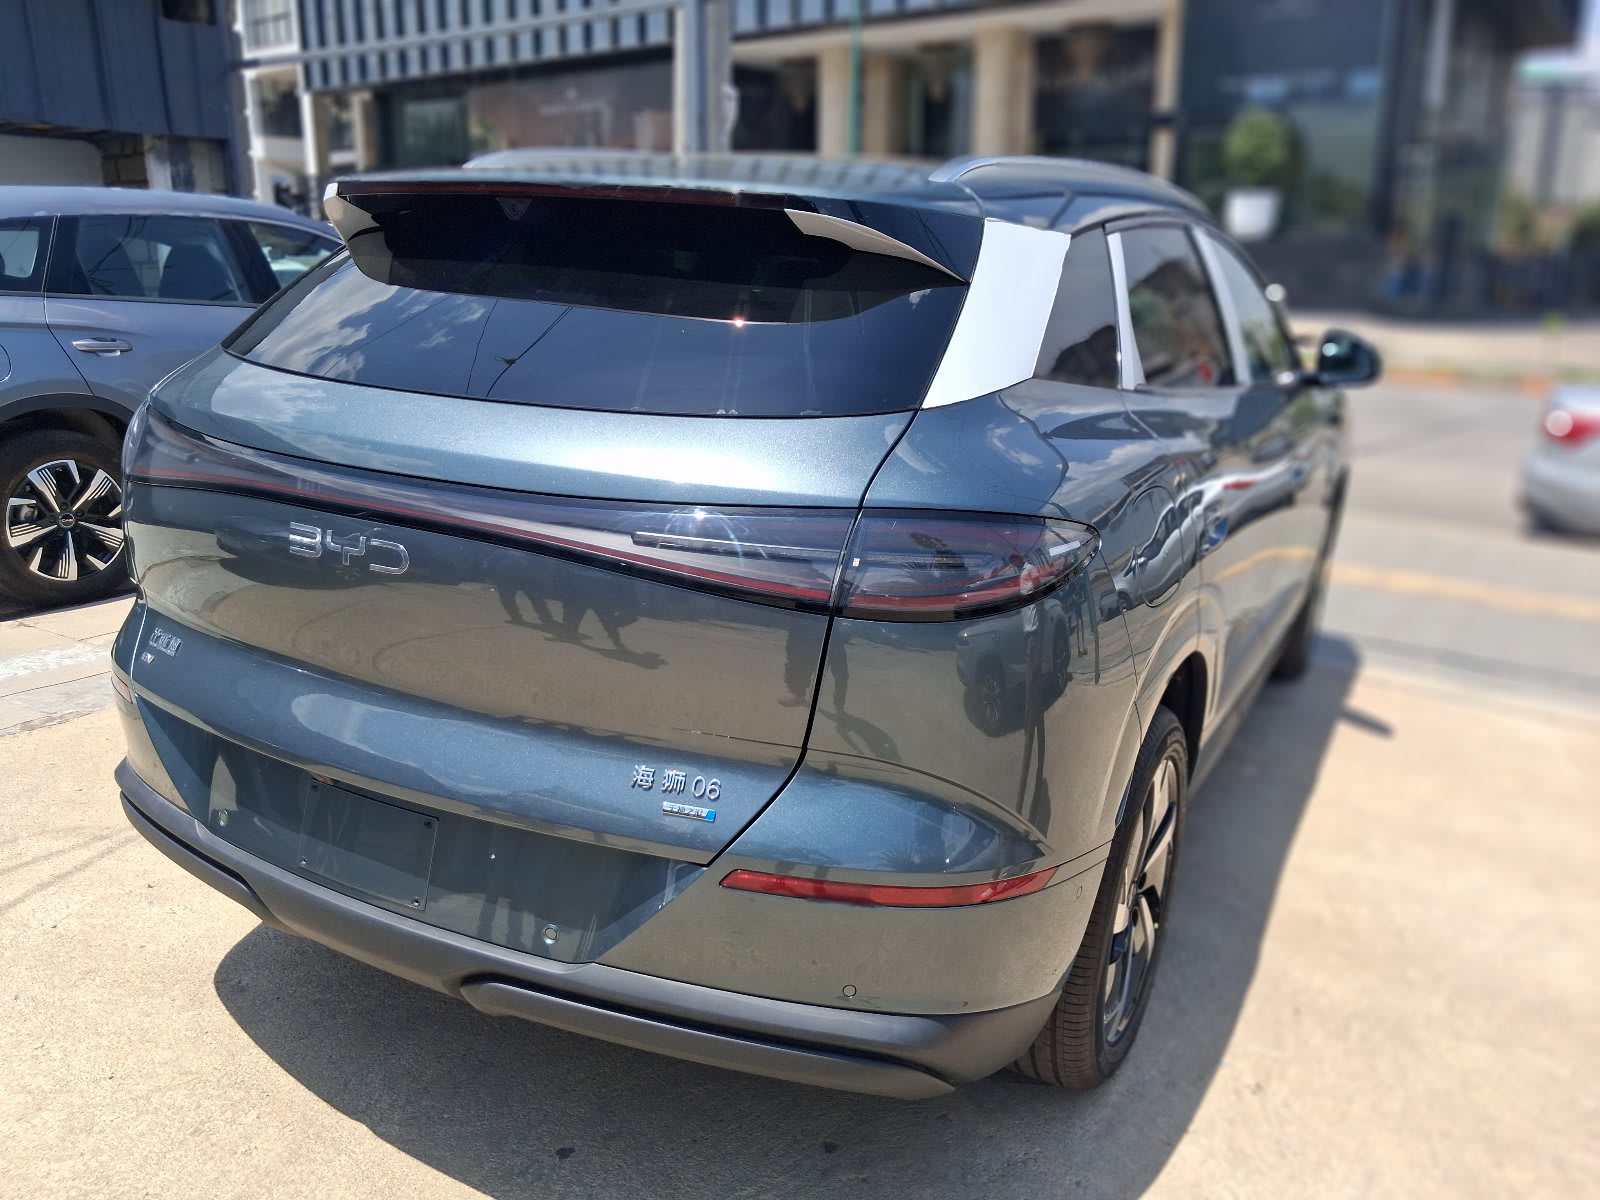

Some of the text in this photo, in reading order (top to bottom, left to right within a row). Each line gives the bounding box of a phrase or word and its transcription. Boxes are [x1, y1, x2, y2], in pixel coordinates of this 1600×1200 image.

[289, 521, 410, 575] BYD
[631, 764, 721, 800] 海狮 06
